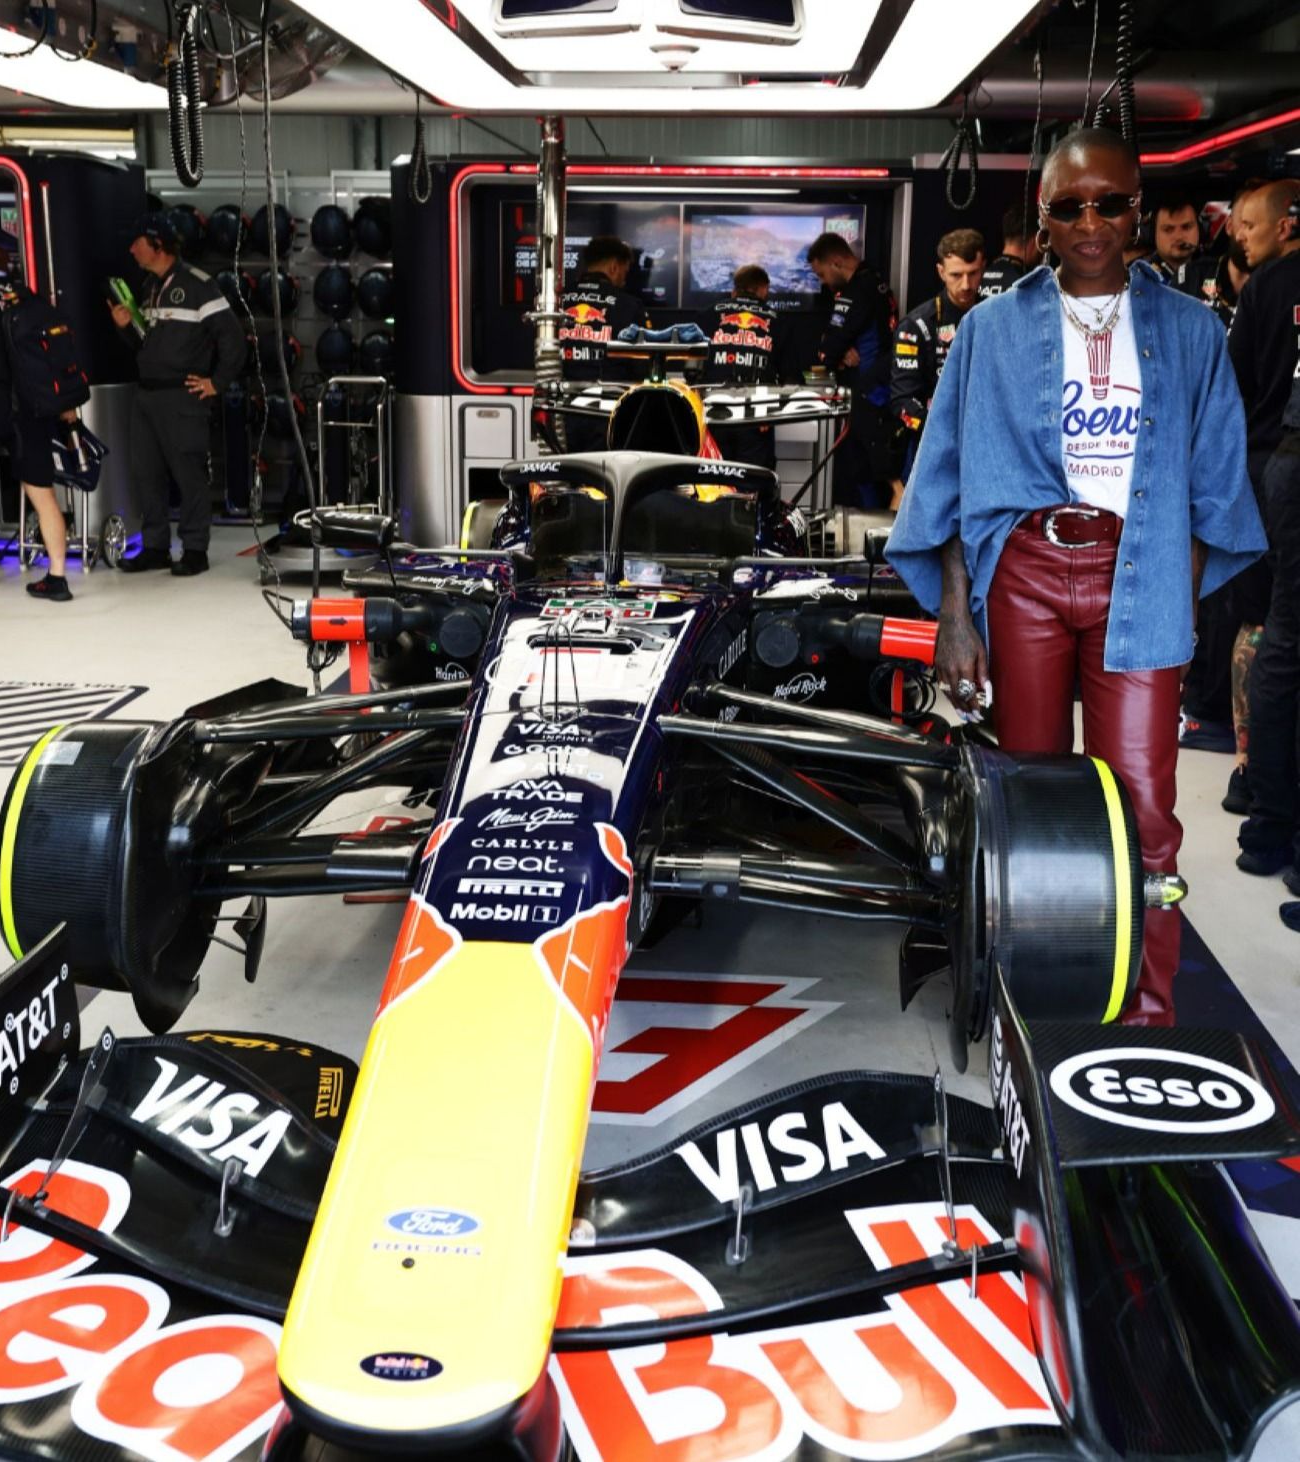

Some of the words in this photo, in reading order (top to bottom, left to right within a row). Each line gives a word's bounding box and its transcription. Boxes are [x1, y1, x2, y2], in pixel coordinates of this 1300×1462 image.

[559, 324, 579, 340] ed
[580, 325, 612, 342] Bull
[714, 351, 753, 367] Mobil
[1063, 380, 1140, 437] Loew
[519, 461, 561, 474] DAMAC
[698, 463, 747, 479] DAMAC
[1067, 463, 1124, 477] MADRID
[718, 629, 748, 680] CARLYLE
[774, 682, 800, 700] Hard
[800, 676, 827, 695] Rock
[517, 723, 580, 735] VISA
[510, 779, 564, 790] AVA
[490, 789, 584, 803] TRADE
[477, 807, 529, 828] Maui
[525, 806, 580, 832] Jim
[470, 838, 574, 851] CARLYLE
[466, 855, 565, 873] neat.
[457, 878, 566, 898] PIRELLI
[450, 903, 530, 922] Mobil
[314, 1066, 345, 1119] PIRELLI
[130, 1056, 294, 1179] VISA
[1000, 1060, 1031, 1180] AT&T
[674, 1101, 887, 1203] VISA
[401, 1210, 465, 1236] Ford
[547, 1203, 1069, 1462] Bull
[372, 1367, 428, 1379] RACING
